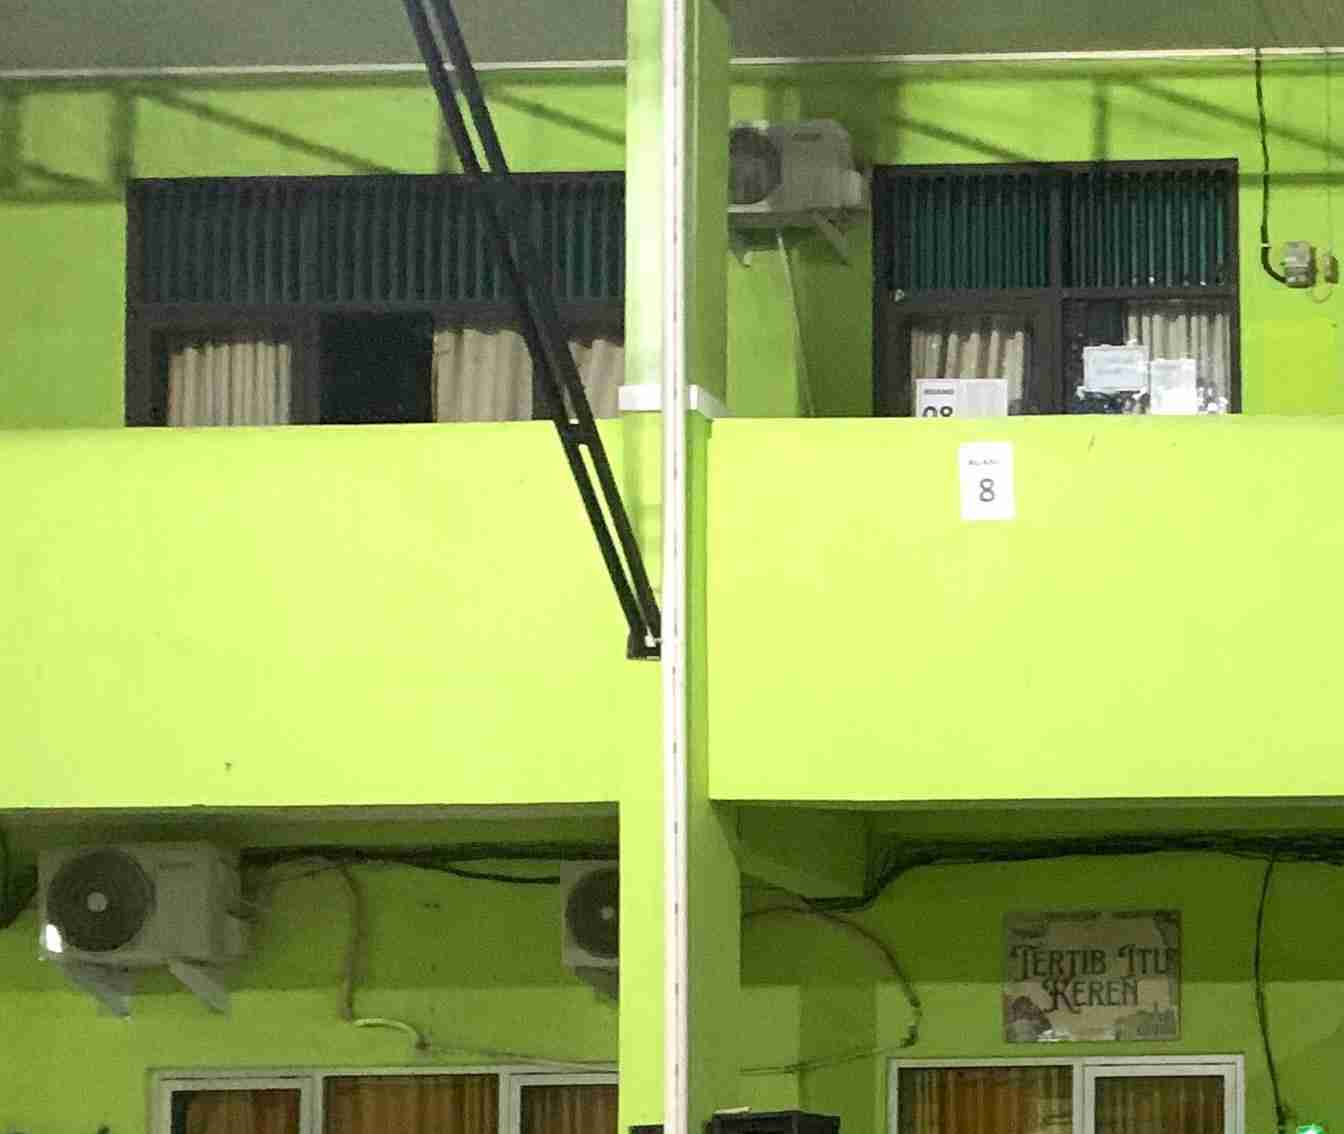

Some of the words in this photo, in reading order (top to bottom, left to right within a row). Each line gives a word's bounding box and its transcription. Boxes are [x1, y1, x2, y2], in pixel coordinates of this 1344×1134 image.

[979, 477, 996, 503] 8
[1009, 944, 1108, 984] TERTIB
[1118, 943, 1177, 977] ITU
[1041, 974, 1139, 1014] KEREN
